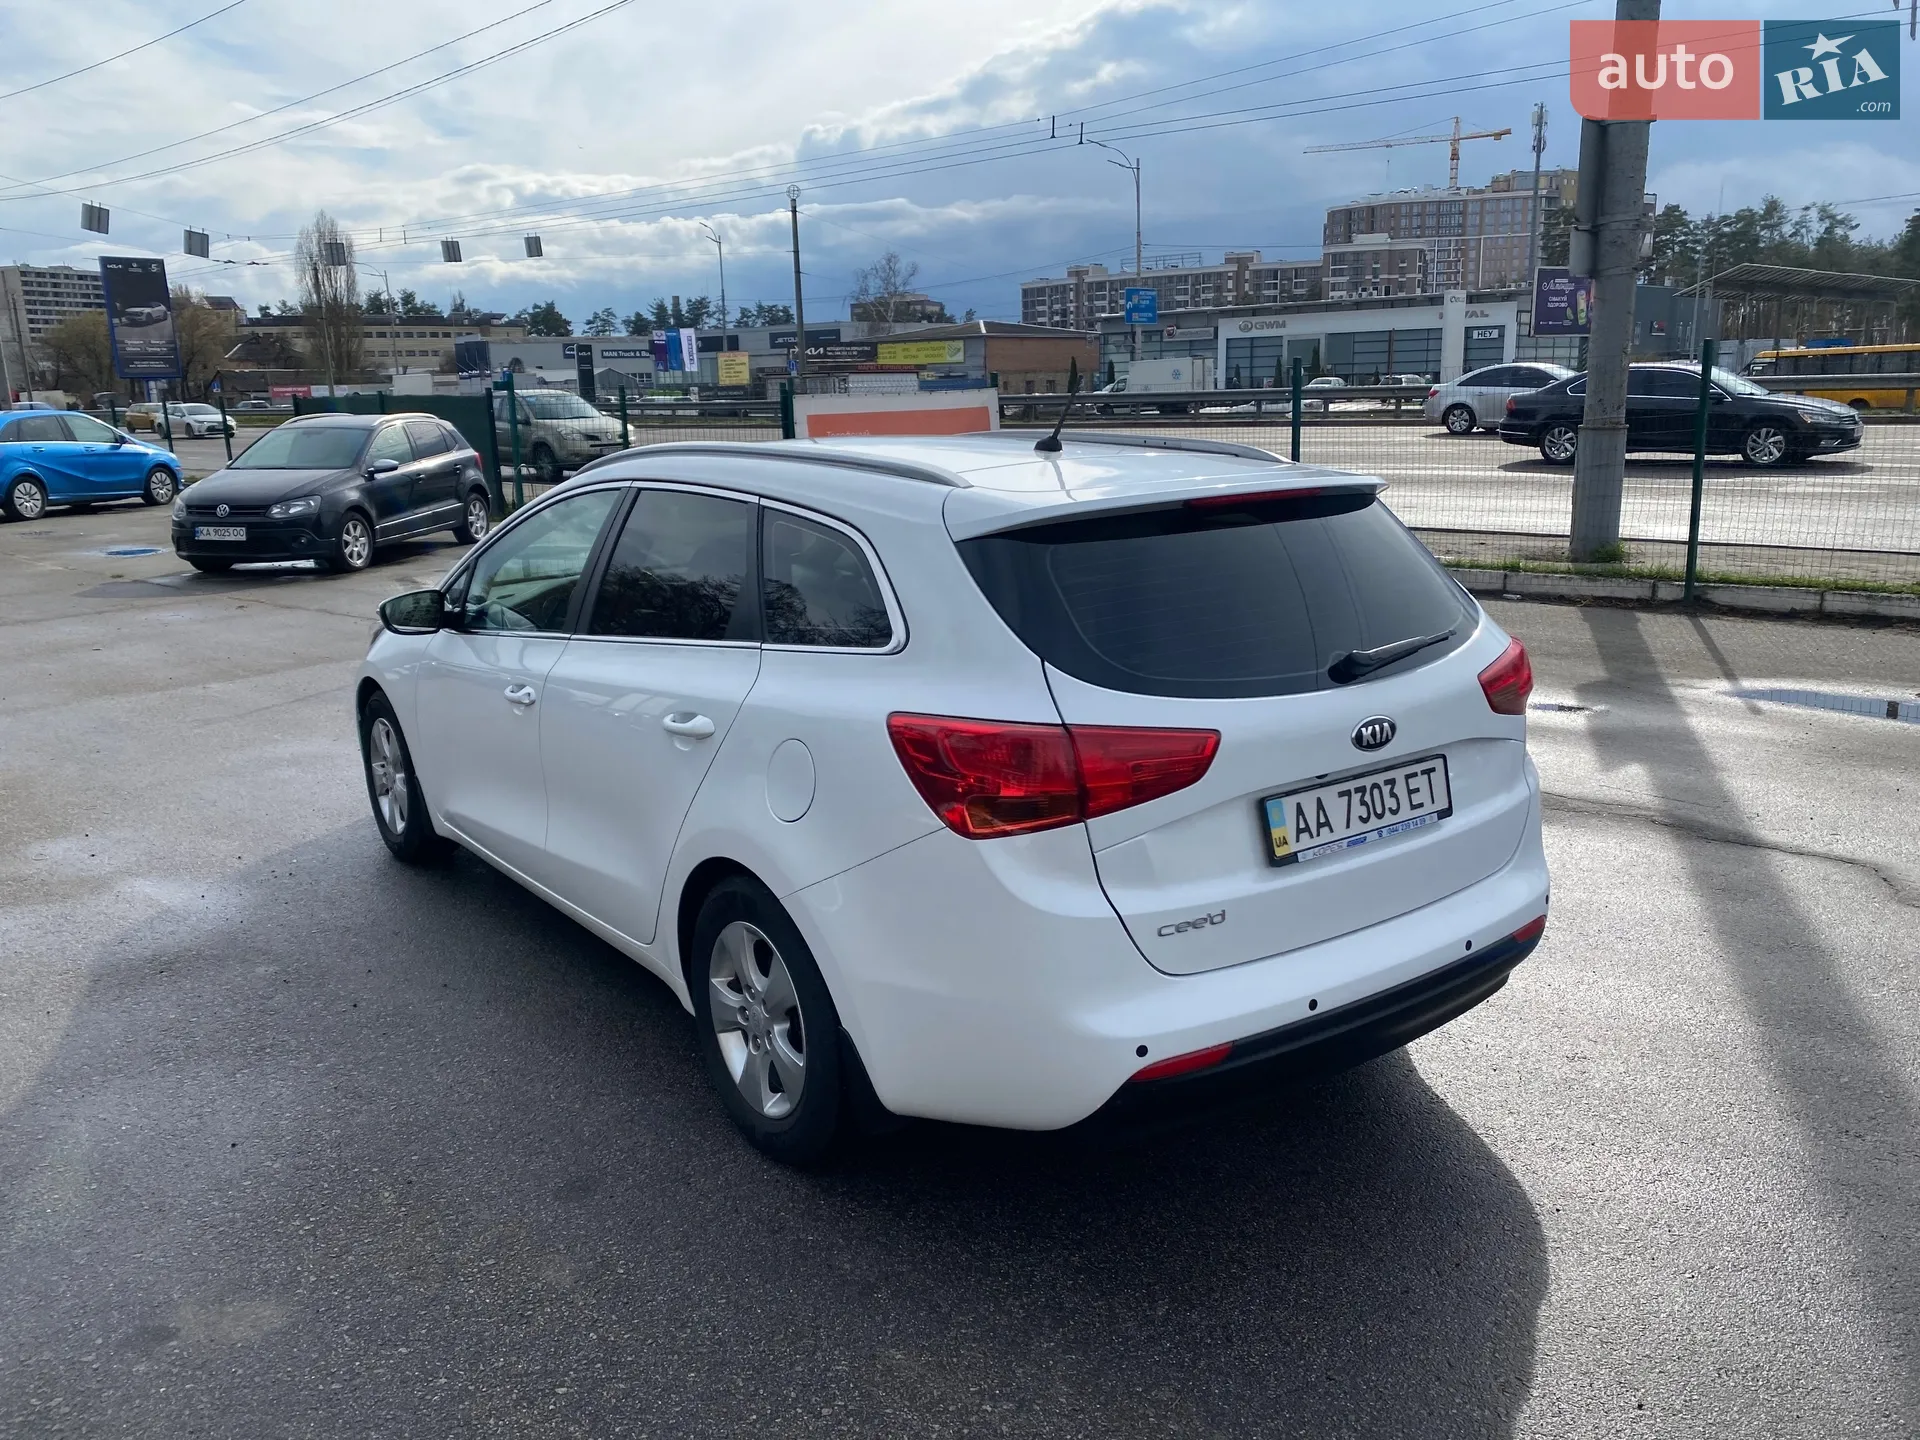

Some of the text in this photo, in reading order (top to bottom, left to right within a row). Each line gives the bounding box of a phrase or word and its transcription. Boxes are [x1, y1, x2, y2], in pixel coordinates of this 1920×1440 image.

[1254, 320, 1287, 330] GWM
[212, 528, 231, 537] 9025
[1360, 722, 1392, 746] KIA
[1295, 766, 1437, 843] AA 7303 ET
[1274, 836, 1289, 848] UA
